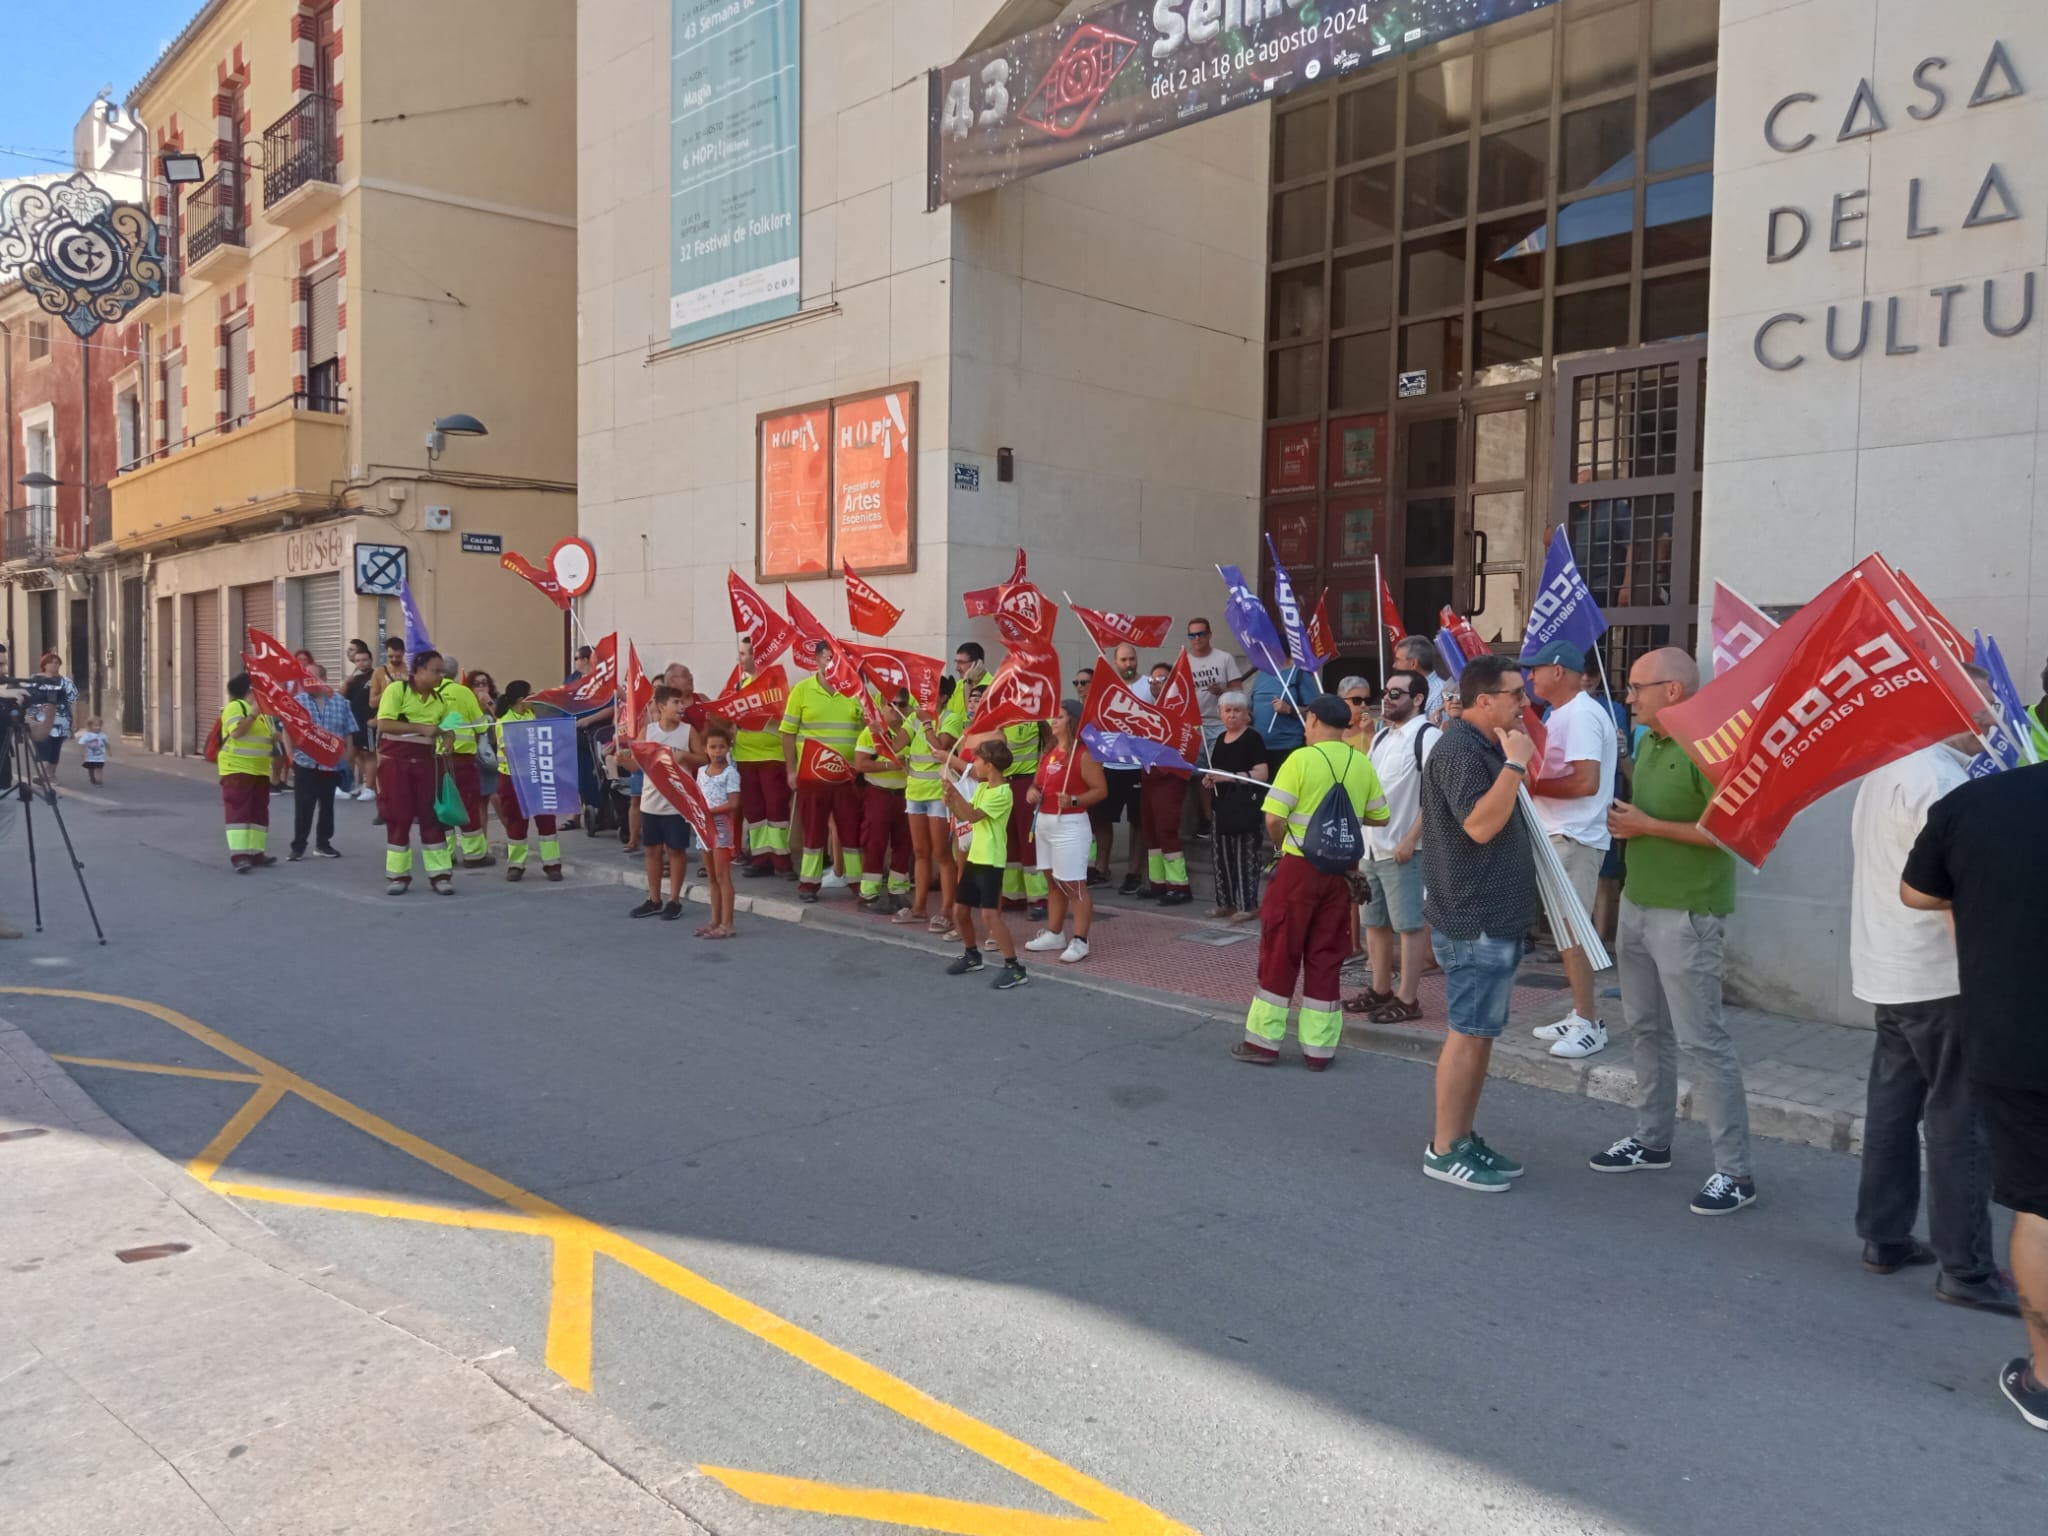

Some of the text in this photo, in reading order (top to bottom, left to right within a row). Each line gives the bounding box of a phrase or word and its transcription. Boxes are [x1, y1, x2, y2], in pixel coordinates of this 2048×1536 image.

[684, 22, 697, 40] 43
[700, 2, 740, 33] Semana
[1152, 0, 1302, 58] Sem
[1151, 73, 1176, 100] del
[1178, 69, 1189, 91] 2
[1191, 61, 1207, 84] al
[1211, 53, 1231, 79] 18
[1234, 47, 1255, 70] de
[1258, 26, 1319, 64] agosto
[1323, 3, 1369, 39] 2024
[683, 84, 712, 107] Magia
[941, 58, 1009, 143] 43
[1764, 39, 2024, 153] CASA
[680, 212, 792, 263] 32 Festival de Folklore
[1766, 162, 2022, 264] DE LA
[843, 493, 881, 514] Artes
[526, 726, 541, 785] país valencià
[537, 726, 555, 784] CCOO
